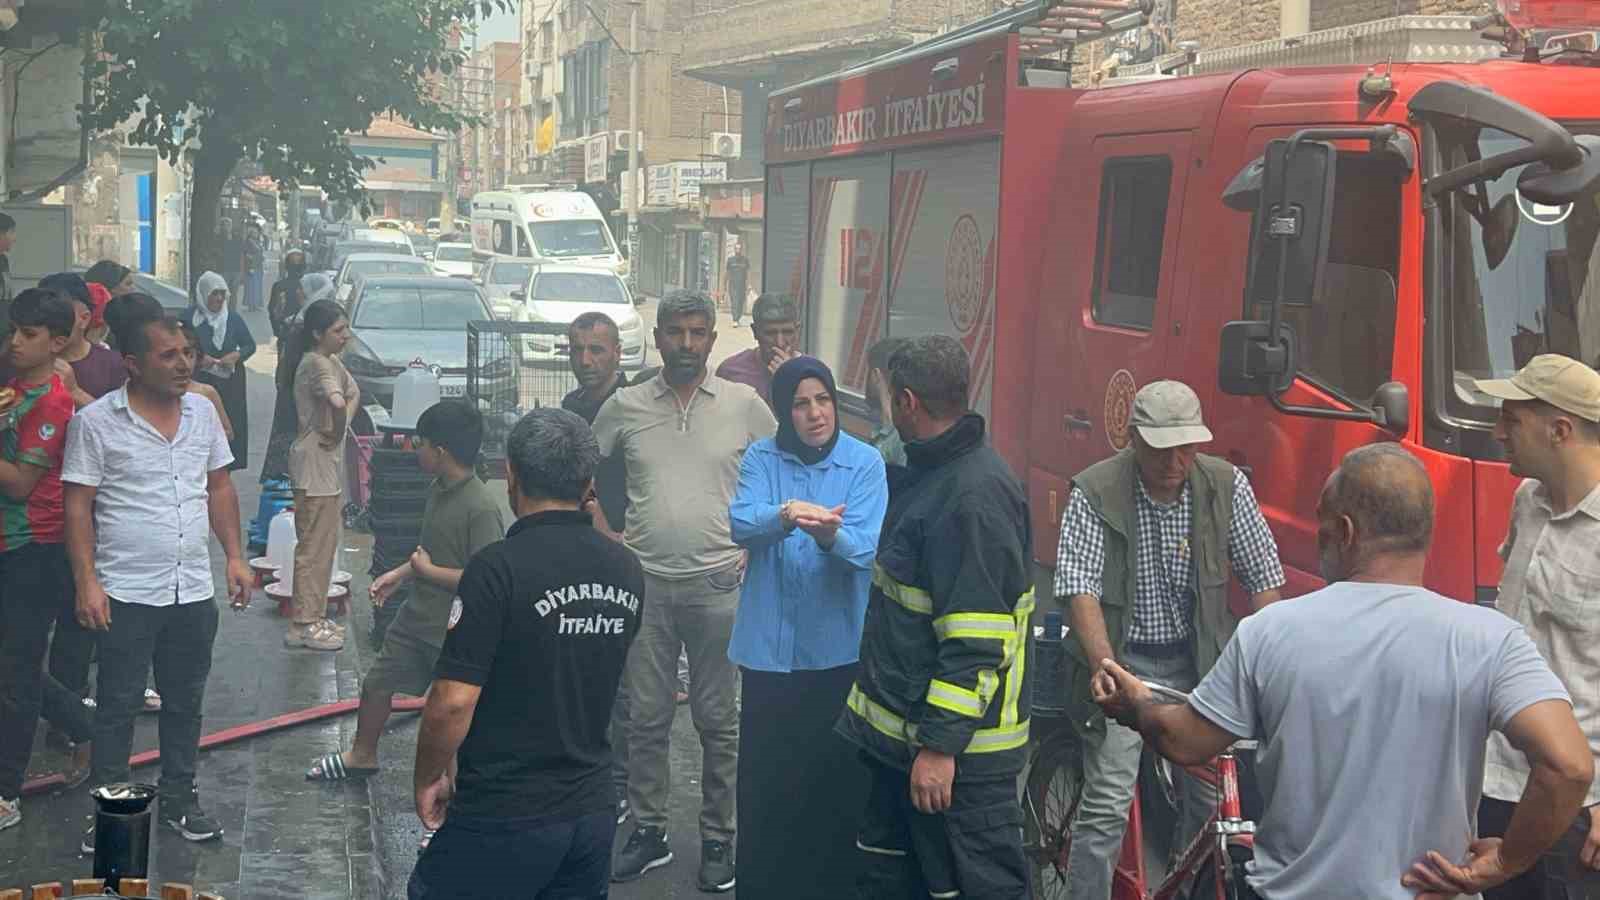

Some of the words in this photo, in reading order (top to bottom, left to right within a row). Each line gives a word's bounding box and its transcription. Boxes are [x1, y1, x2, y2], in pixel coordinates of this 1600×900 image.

[885, 73, 986, 138] İTFAİYESİ
[840, 228, 873, 289] 112
[559, 613, 625, 634] İTFAİYE
